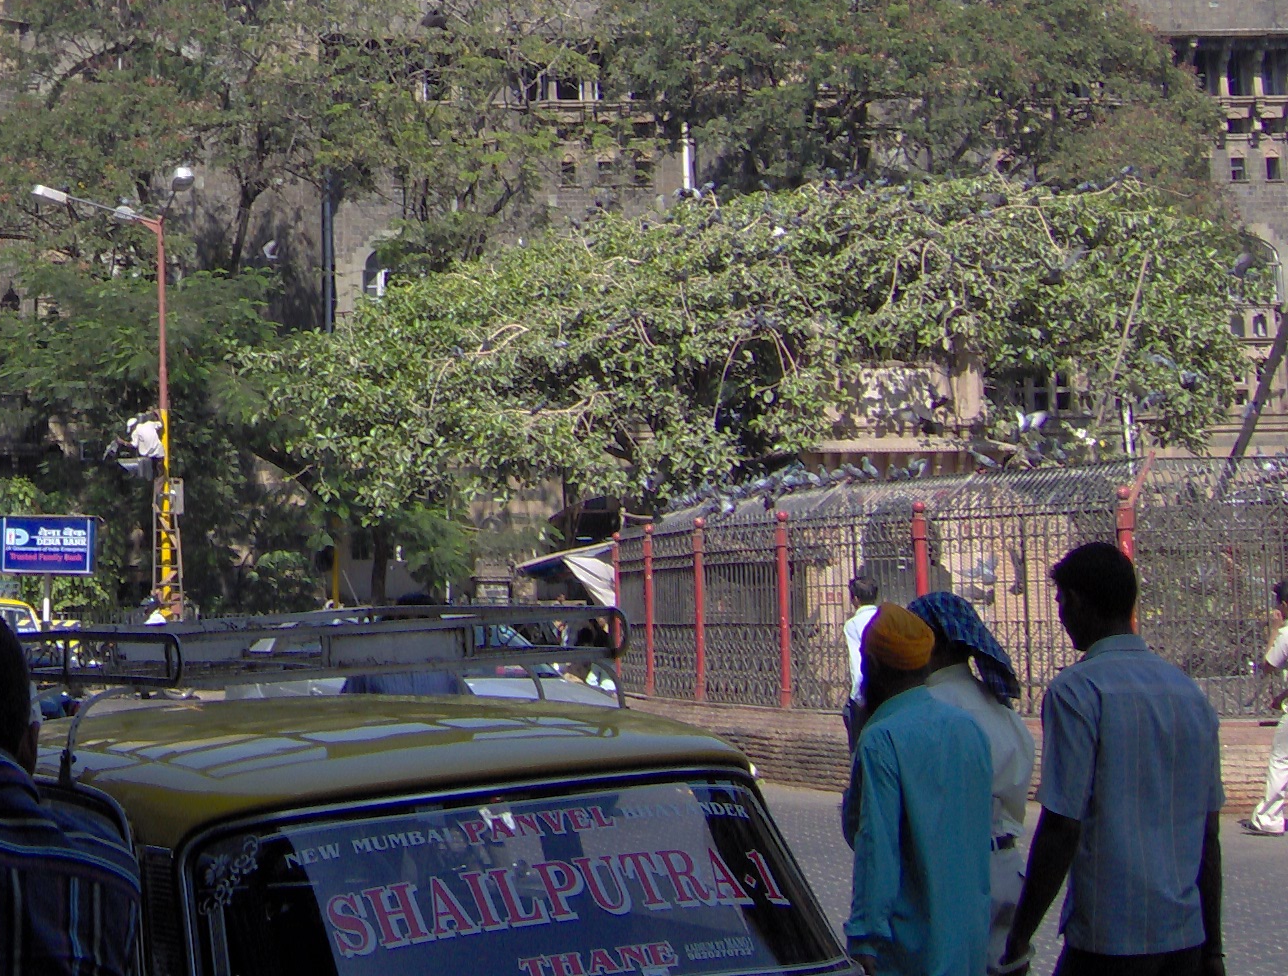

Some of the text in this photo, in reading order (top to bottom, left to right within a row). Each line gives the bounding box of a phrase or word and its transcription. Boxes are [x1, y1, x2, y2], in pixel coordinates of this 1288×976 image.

[37, 537, 87, 545] DENA BANK
[11, 553, 37, 561] Trusted
[40, 554, 63, 562] Family
[284, 801, 749, 869] NEW MUMBAI PANVEL BHAYANDER
[518, 940, 679, 976] THANE
